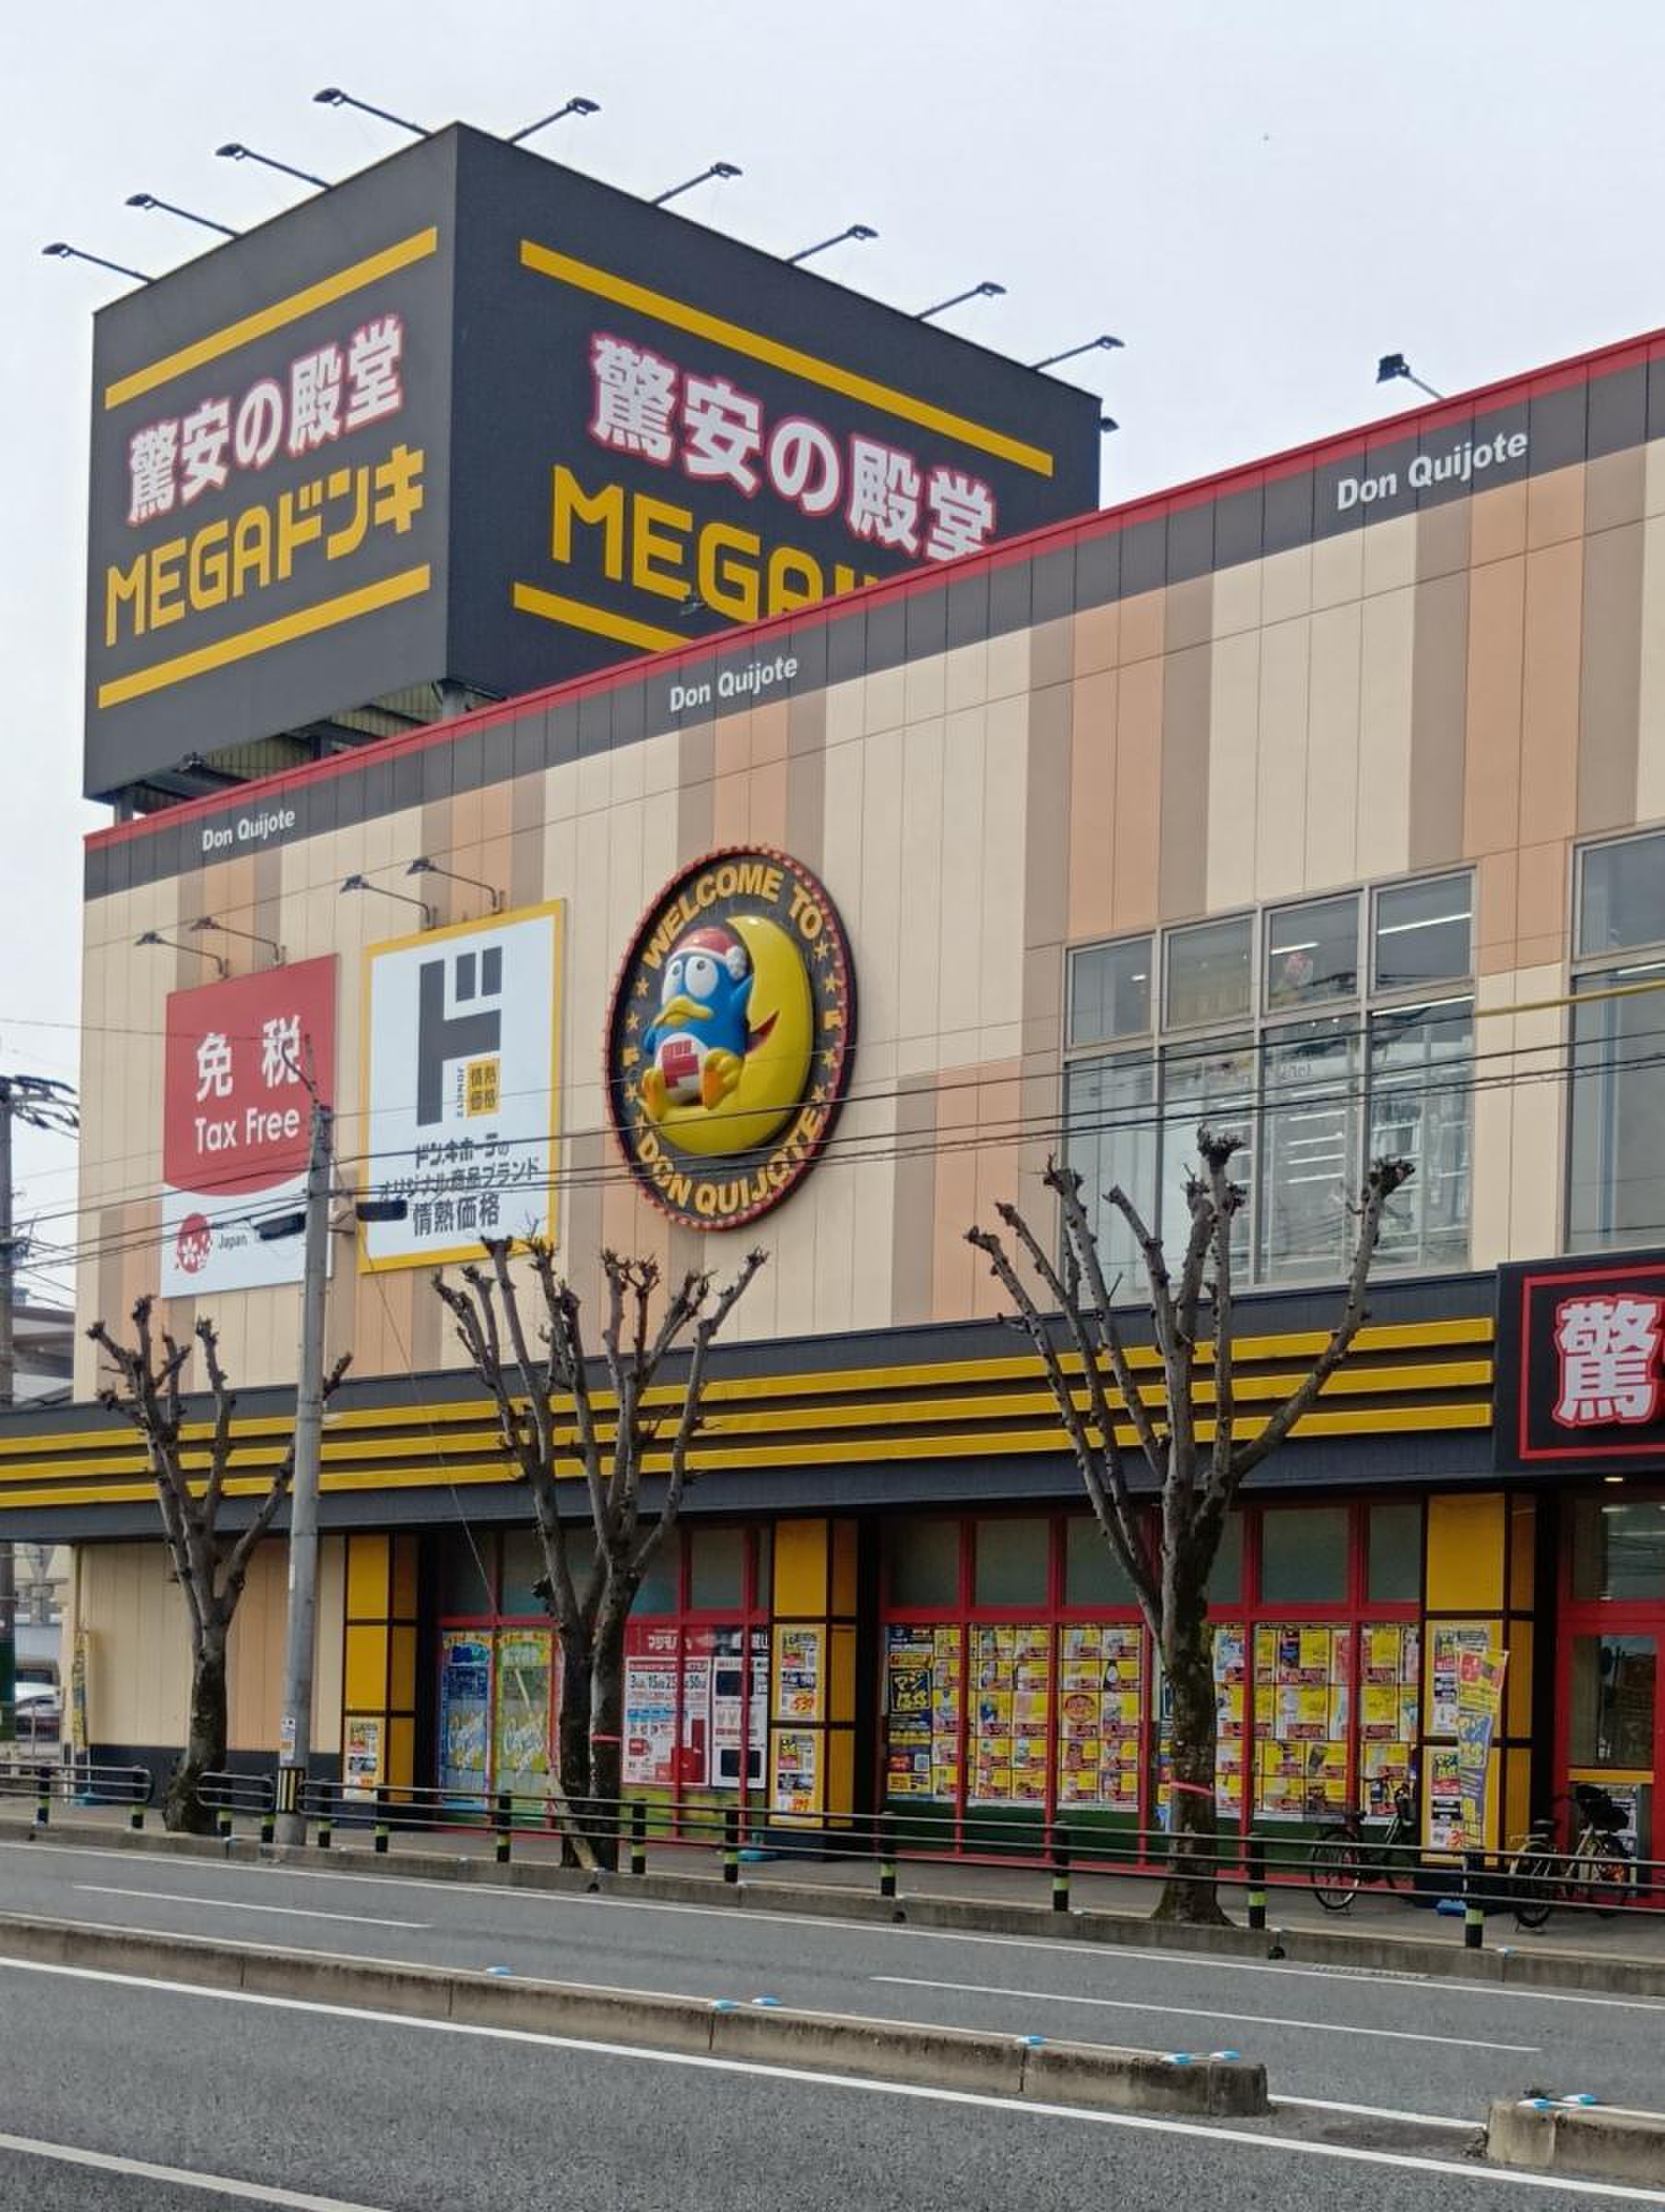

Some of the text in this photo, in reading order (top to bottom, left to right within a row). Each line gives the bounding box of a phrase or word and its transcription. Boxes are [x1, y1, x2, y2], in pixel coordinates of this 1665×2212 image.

[129, 313, 404, 526] 驚安の殿堂
[591, 333, 997, 561] 驚安の殿堂
[1338, 433, 1528, 511] Don Quijote
[106, 444, 424, 647] MEGAドンキ
[553, 465, 879, 621] MEGA
[670, 657, 797, 712] Don Quijote
[203, 809, 296, 851] Don Quijote
[642, 864, 823, 969] WELCOME TO
[196, 1015, 301, 1102] 免税
[195, 1108, 301, 1154] Tax Free
[638, 1107, 823, 1216] DON QUIJOTE
[413, 1193, 501, 1236] 情熱価格
[1552, 1293, 1665, 1427] 驚
